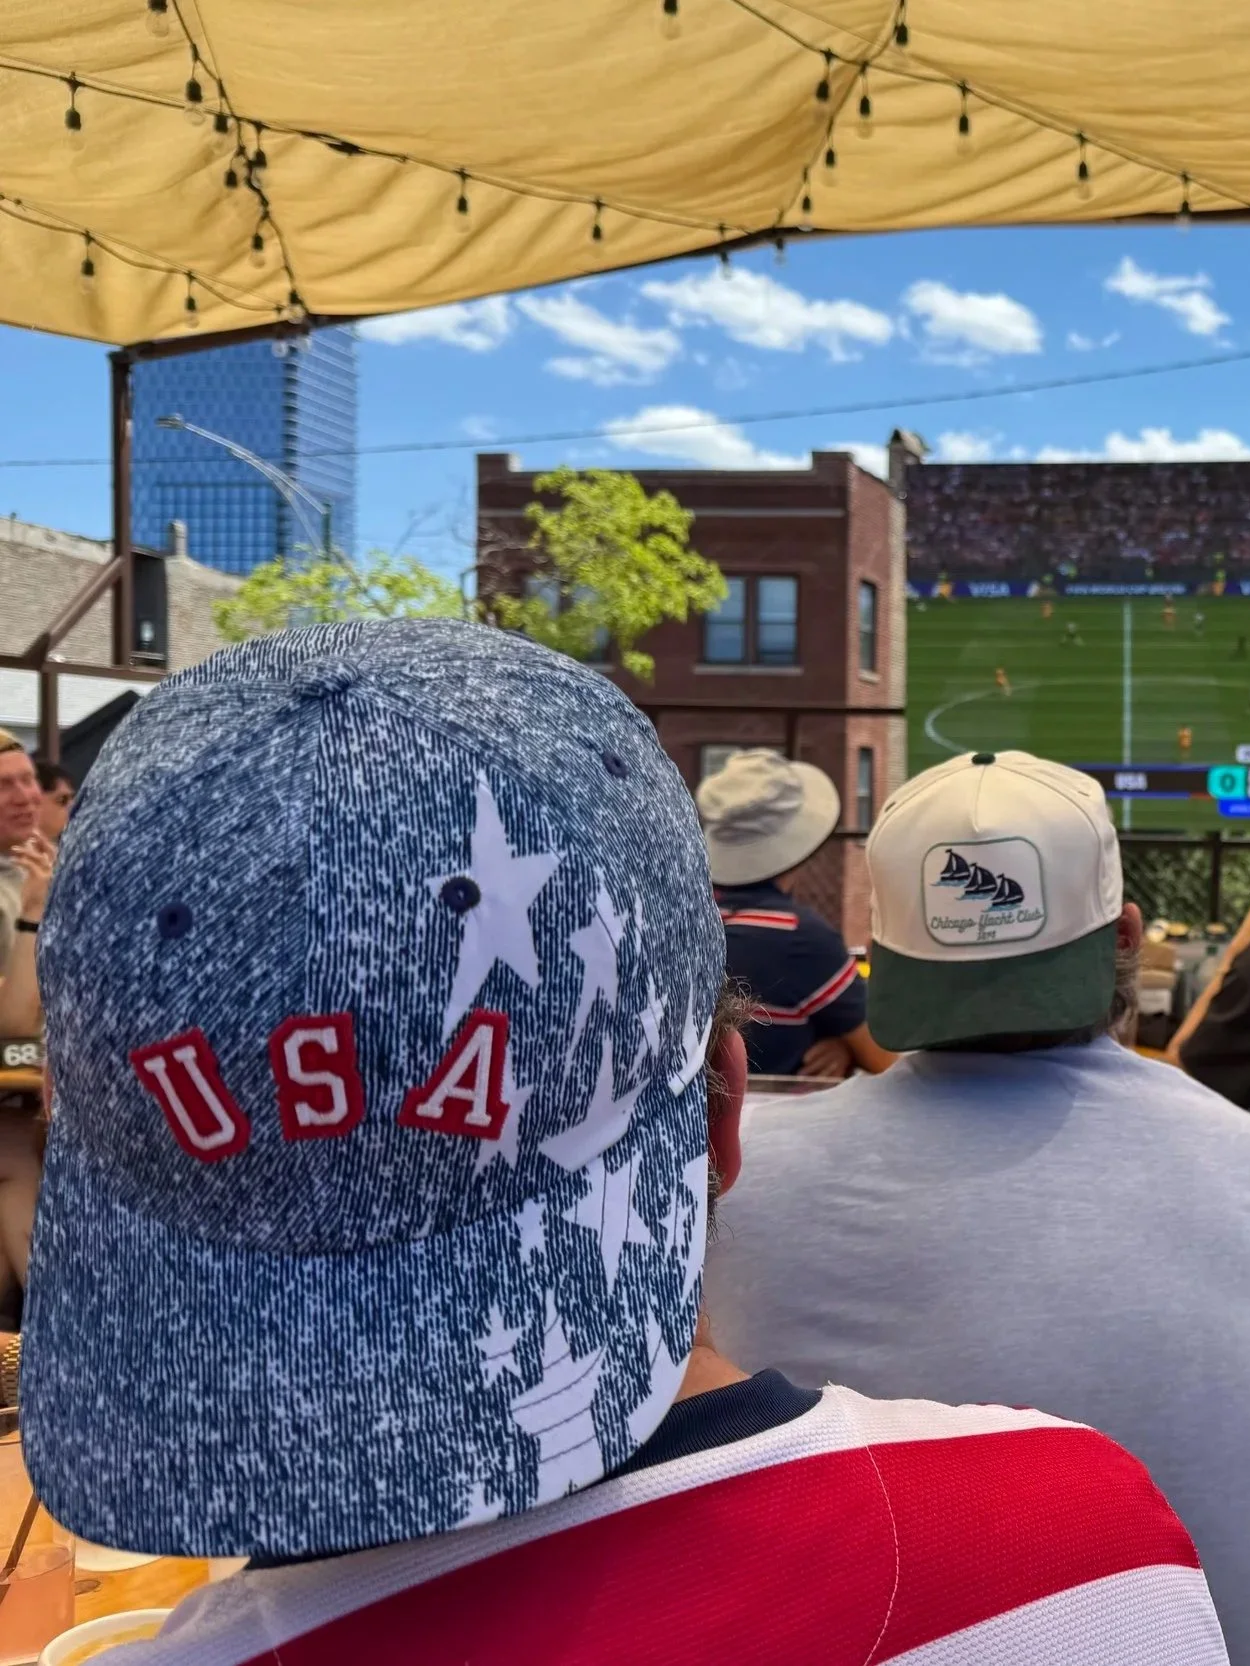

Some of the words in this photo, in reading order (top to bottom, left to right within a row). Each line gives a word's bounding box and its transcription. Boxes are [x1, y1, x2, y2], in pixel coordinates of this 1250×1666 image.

[1219, 773, 1236, 792] 0
[930, 916, 977, 934] Chicago
[977, 911, 1016, 933] Yacht
[1017, 907, 1044, 923] Club
[4, 1044, 38, 1067] 68
[138, 1017, 501, 1155] USA
